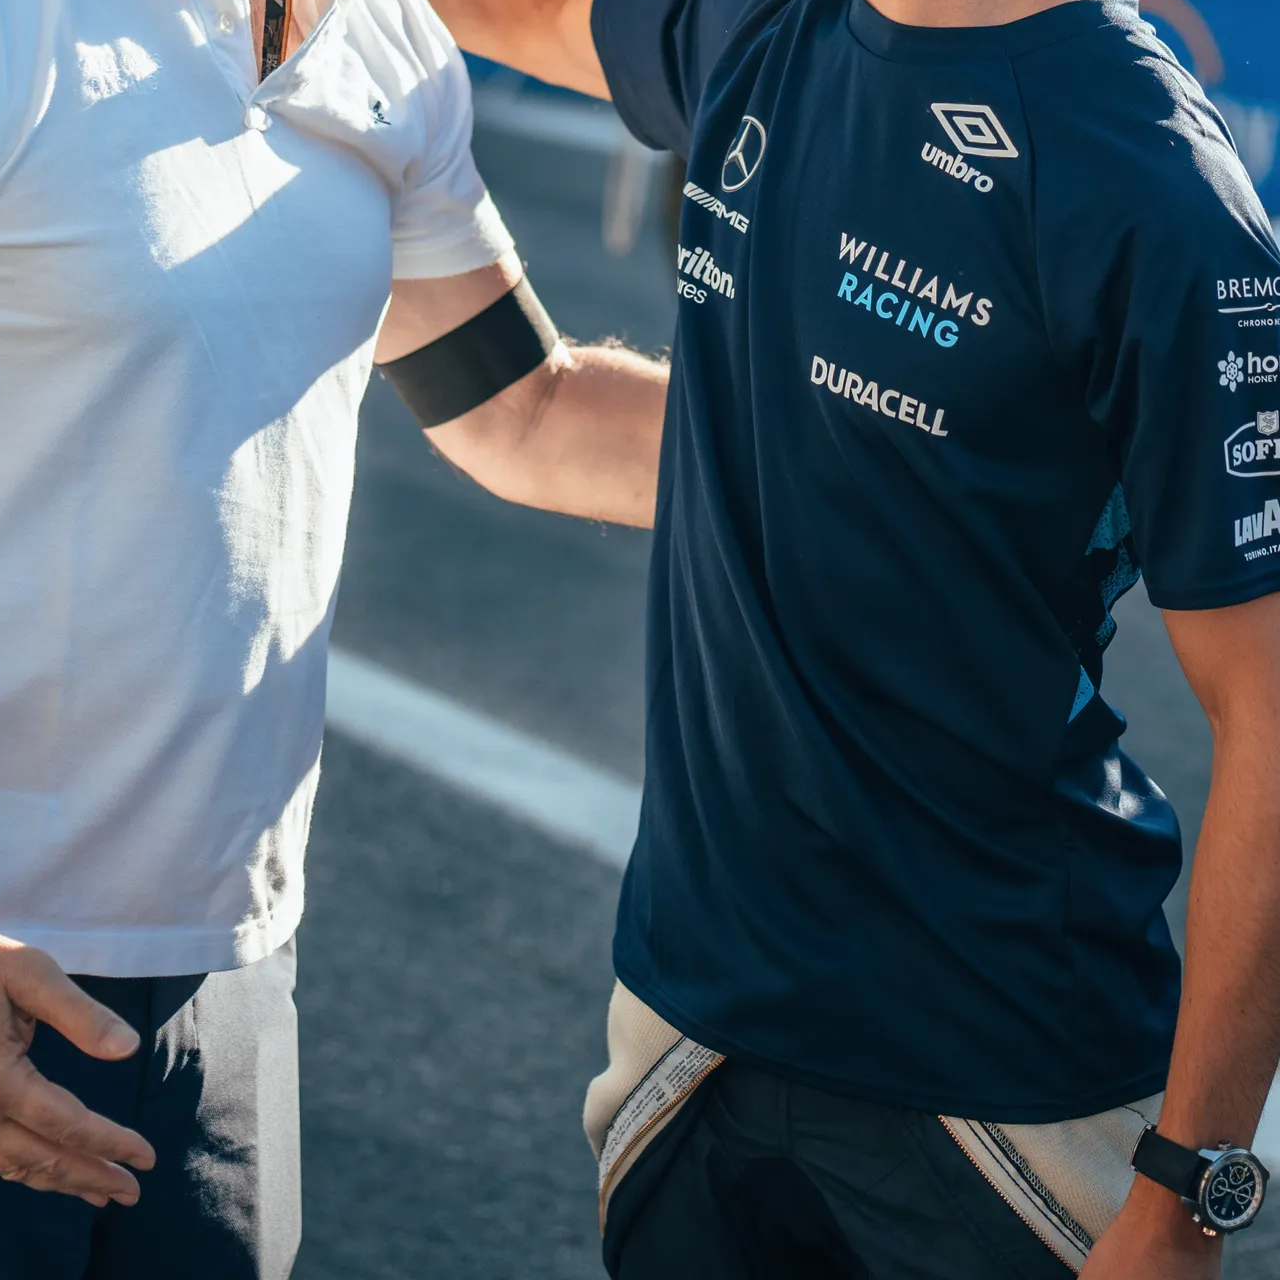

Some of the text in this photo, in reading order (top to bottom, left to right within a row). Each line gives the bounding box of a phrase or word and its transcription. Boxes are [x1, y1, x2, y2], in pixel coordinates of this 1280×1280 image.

[921, 142, 994, 193] umbro
[678, 244, 735, 299] rilton
[839, 232, 993, 326] WILLIAMS
[837, 272, 959, 348] RACING
[810, 355, 948, 437] DURACELL
[1248, 374, 1278, 384] HONEY
[1244, 547, 1269, 562] TORINO,
